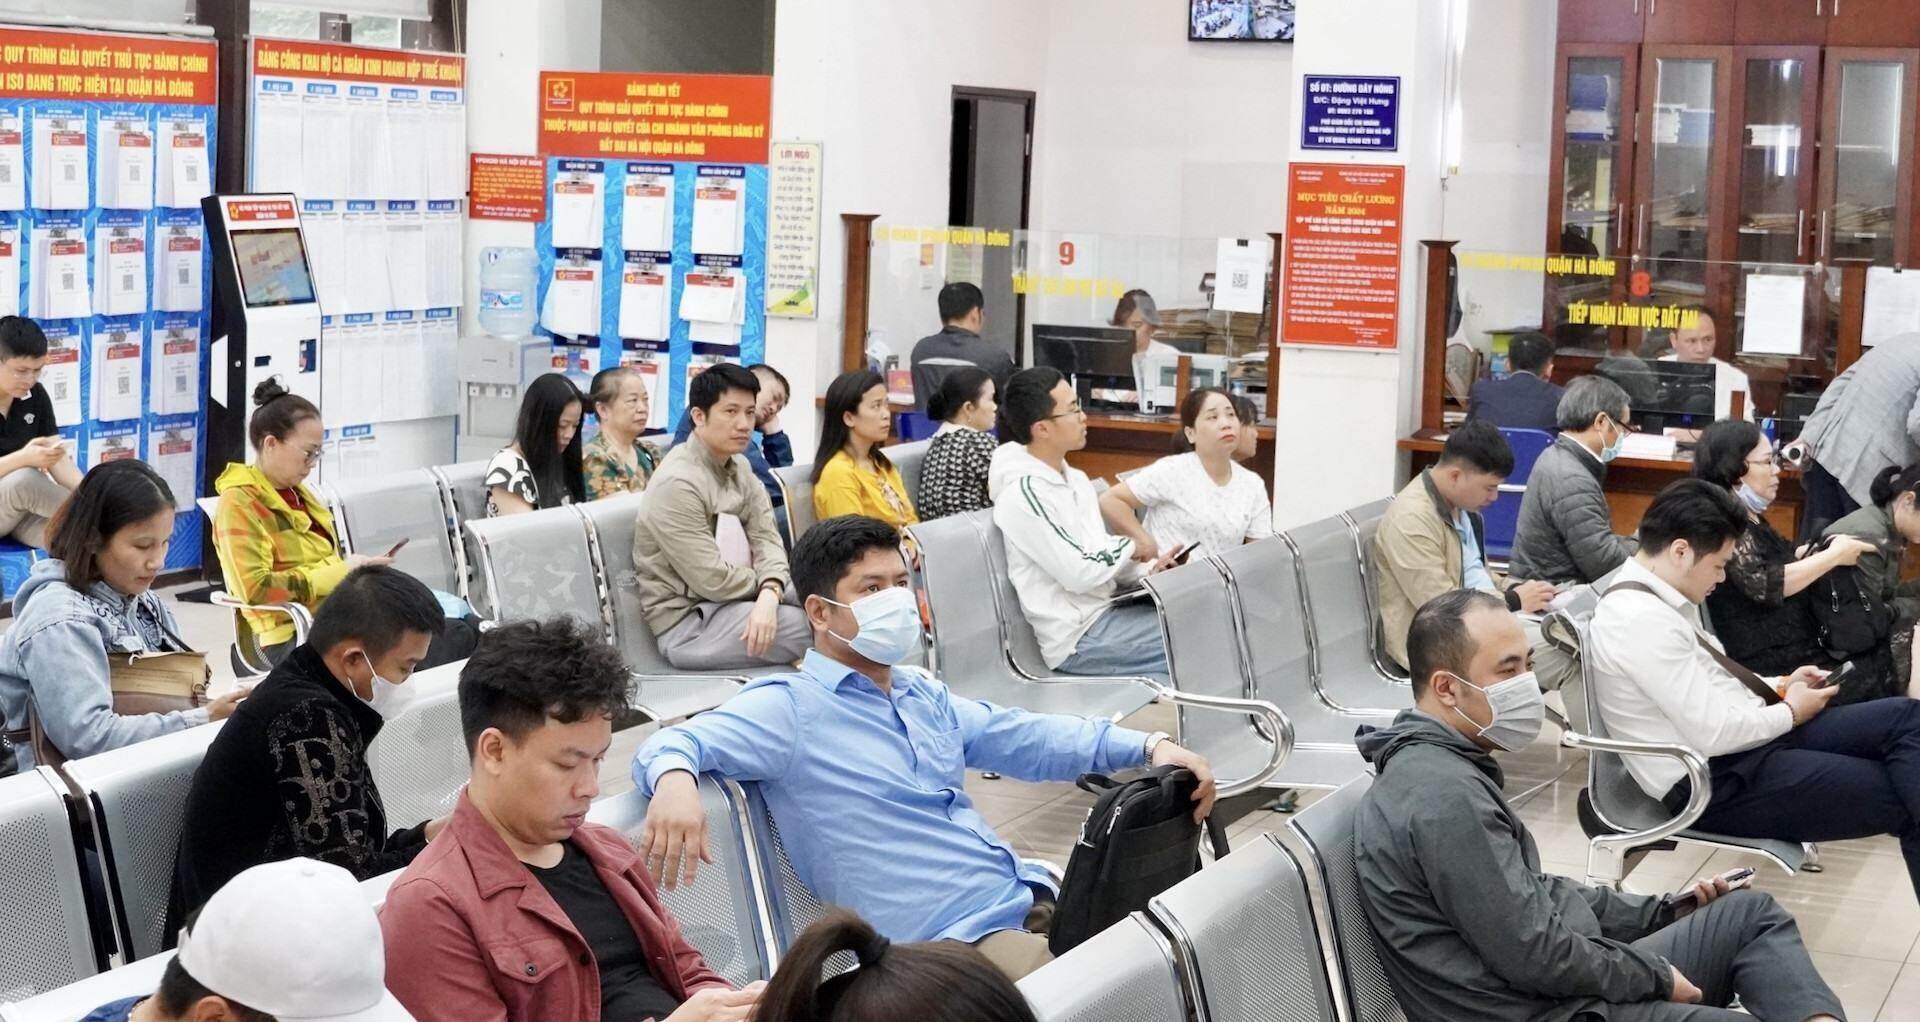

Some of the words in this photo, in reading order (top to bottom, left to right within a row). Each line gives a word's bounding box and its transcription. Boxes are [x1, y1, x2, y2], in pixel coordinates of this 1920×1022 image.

[5, 45, 24, 64] QUY
[27, 44, 57, 65] TRÌNH
[59, 43, 80, 66] GIẢI
[82, 46, 113, 68] QUYẾT
[114, 47, 132, 69] THỦ
[134, 52, 152, 72] TỤC
[154, 52, 179, 72] HÀNH
[181, 52, 208, 73] CHÍNH
[258, 44, 279, 68] BẢNG
[280, 49, 300, 70] CÔNG
[302, 53, 319, 71] KHAI
[320, 53, 330, 76] HỘ
[332, 53, 342, 72] CÁ
[344, 54, 363, 74] NHÂN
[365, 59, 381, 75] KINH
[383, 59, 405, 77] DOANH
[422, 59, 439, 80] THUẾ
[7, 73, 24, 90] ISO
[26, 74, 55, 91] ĐANG
[57, 75, 82, 96] THỰC
[84, 75, 107, 96] HIỆN
[109, 77, 125, 98] TẠI
[126, 77, 152, 98] QUẬN
[154, 76, 167, 96] HÀ
[169, 78, 194, 97] ĐÔNG
[668, 82, 681, 97] YẾT
[1309, 81, 1320, 92] SỐ
[579, 101, 592, 115] QUY
[632, 101, 654, 116] QUYẾT
[1297, 192, 1316, 202] MỤC
[1059, 241, 1074, 266] 9
[1547, 256, 1573, 277] QUẬN
[1574, 256, 1587, 274] HÀ
[1589, 257, 1615, 276] ĐÔNG
[1630, 270, 1650, 297] 8
[1568, 299, 1588, 324] TIẾP
[1589, 301, 1616, 329] NHẬN
[1617, 302, 1639, 326] LĨNH
[1641, 305, 1660, 331] VỰC
[1661, 303, 1680, 328] ĐẤT
